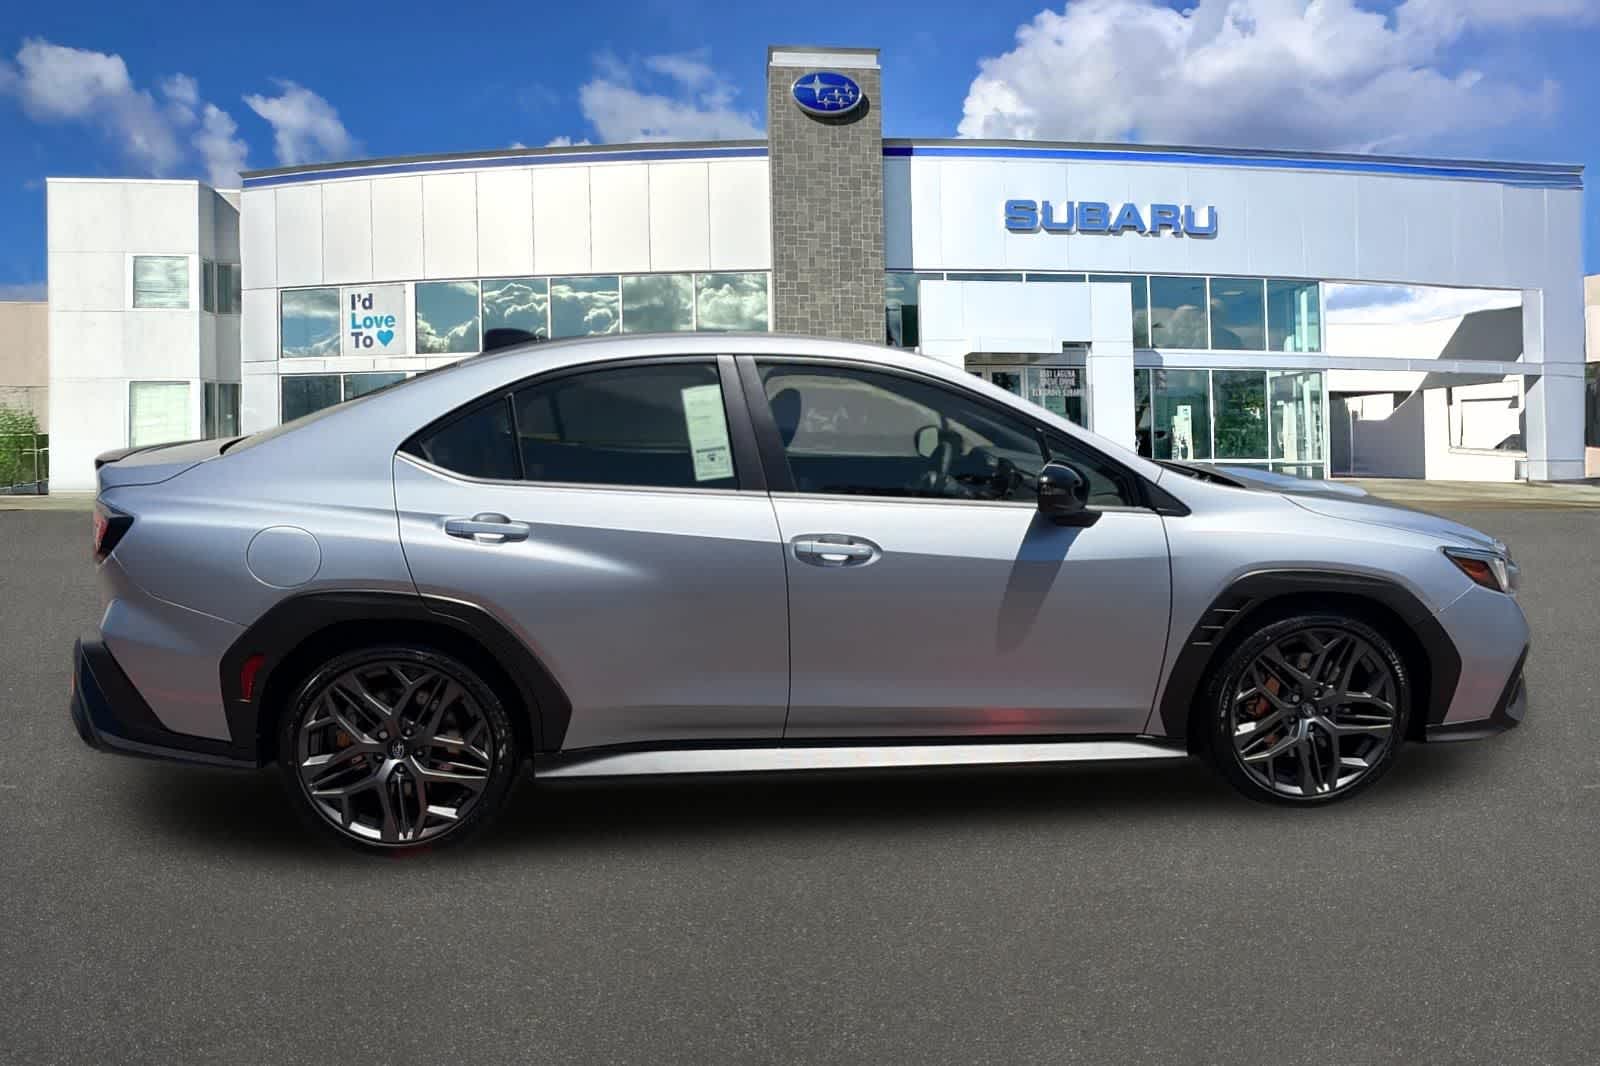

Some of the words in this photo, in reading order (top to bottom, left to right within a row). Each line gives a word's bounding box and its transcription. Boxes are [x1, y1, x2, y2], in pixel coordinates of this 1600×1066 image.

[1005, 199, 1217, 237] SUBARU
[351, 293, 373, 310] I'd
[351, 312, 396, 330] Love
[351, 331, 374, 348] To
